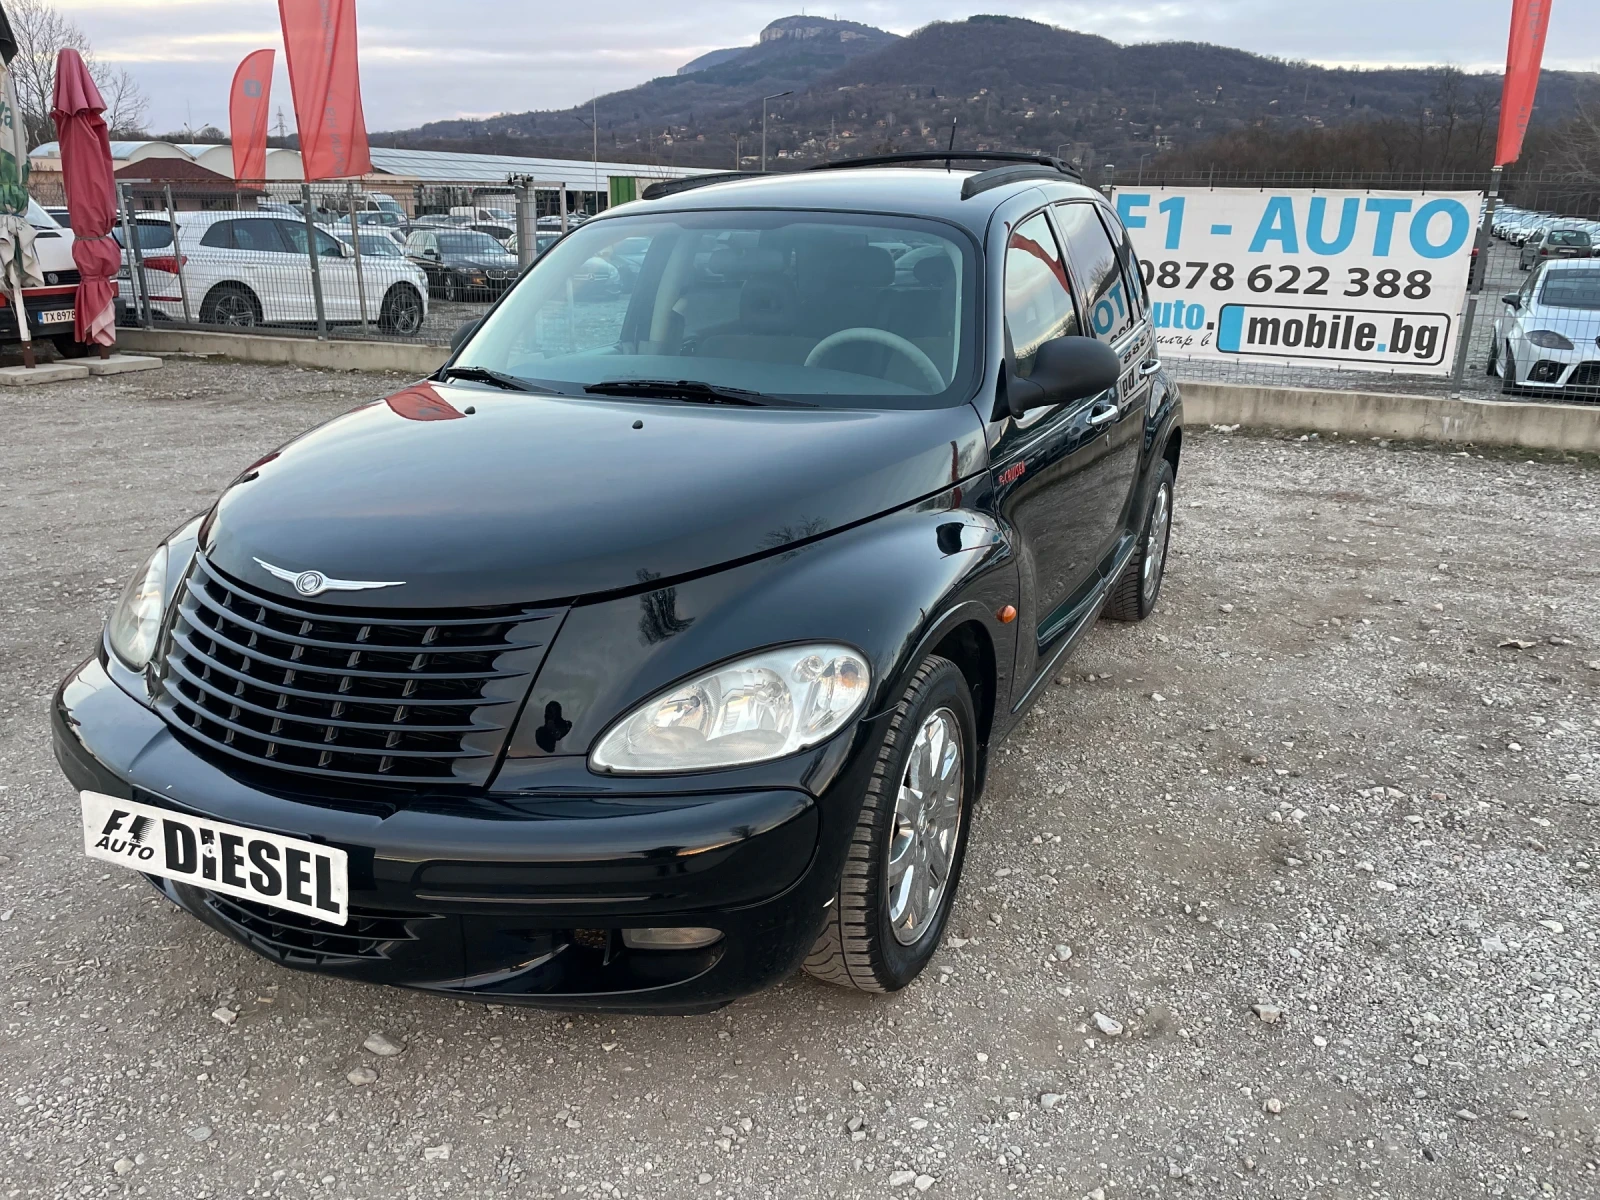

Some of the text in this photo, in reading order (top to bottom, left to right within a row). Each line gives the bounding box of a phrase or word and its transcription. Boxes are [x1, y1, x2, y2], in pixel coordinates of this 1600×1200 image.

[1117, 194, 1185, 249] F1
[1248, 196, 1470, 259] AUTO
[1247, 264, 1330, 295] 622
[1343, 267, 1432, 300] 388
[1153, 300, 1215, 330] uto.
[1247, 313, 1439, 359] mobile.bg
[95, 836, 155, 860] AUTO
[163, 819, 340, 914] DIESEL
